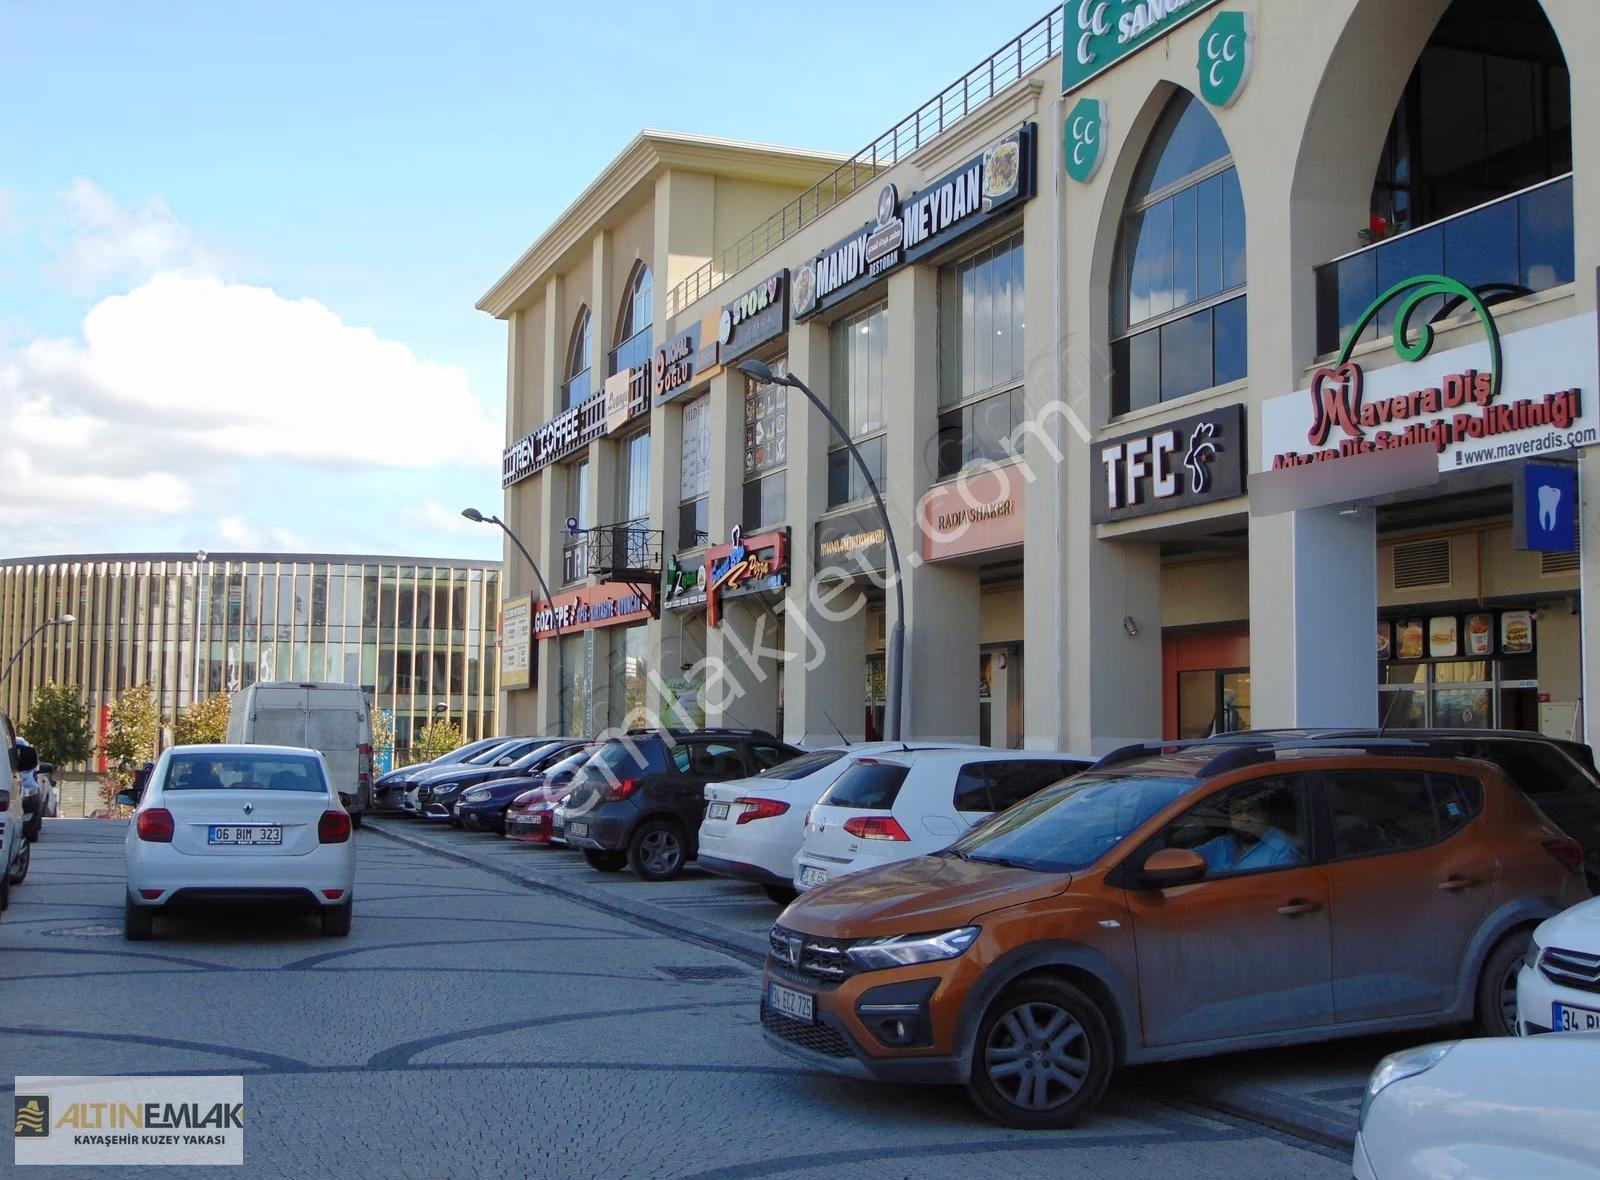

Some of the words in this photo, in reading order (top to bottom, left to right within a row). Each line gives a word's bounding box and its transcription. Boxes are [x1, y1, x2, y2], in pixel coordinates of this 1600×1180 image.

[816, 234, 868, 299] MANDY
[903, 164, 982, 249] MEYDAN
[732, 277, 777, 326] STORY
[540, 407, 579, 455] COFFEE
[1309, 376, 1442, 446] Mavera
[1443, 369, 1492, 407] Diş
[1453, 388, 1581, 441] Polikliniği
[1102, 429, 1176, 509] TFC
[1464, 428, 1596, 464] www.maveradis.com
[748, 554, 769, 580] Pizza
[216, 828, 229, 840] 06
[236, 828, 252, 840] BIM
[260, 828, 280, 840] 323
[1562, 1009, 1579, 1031] 34
